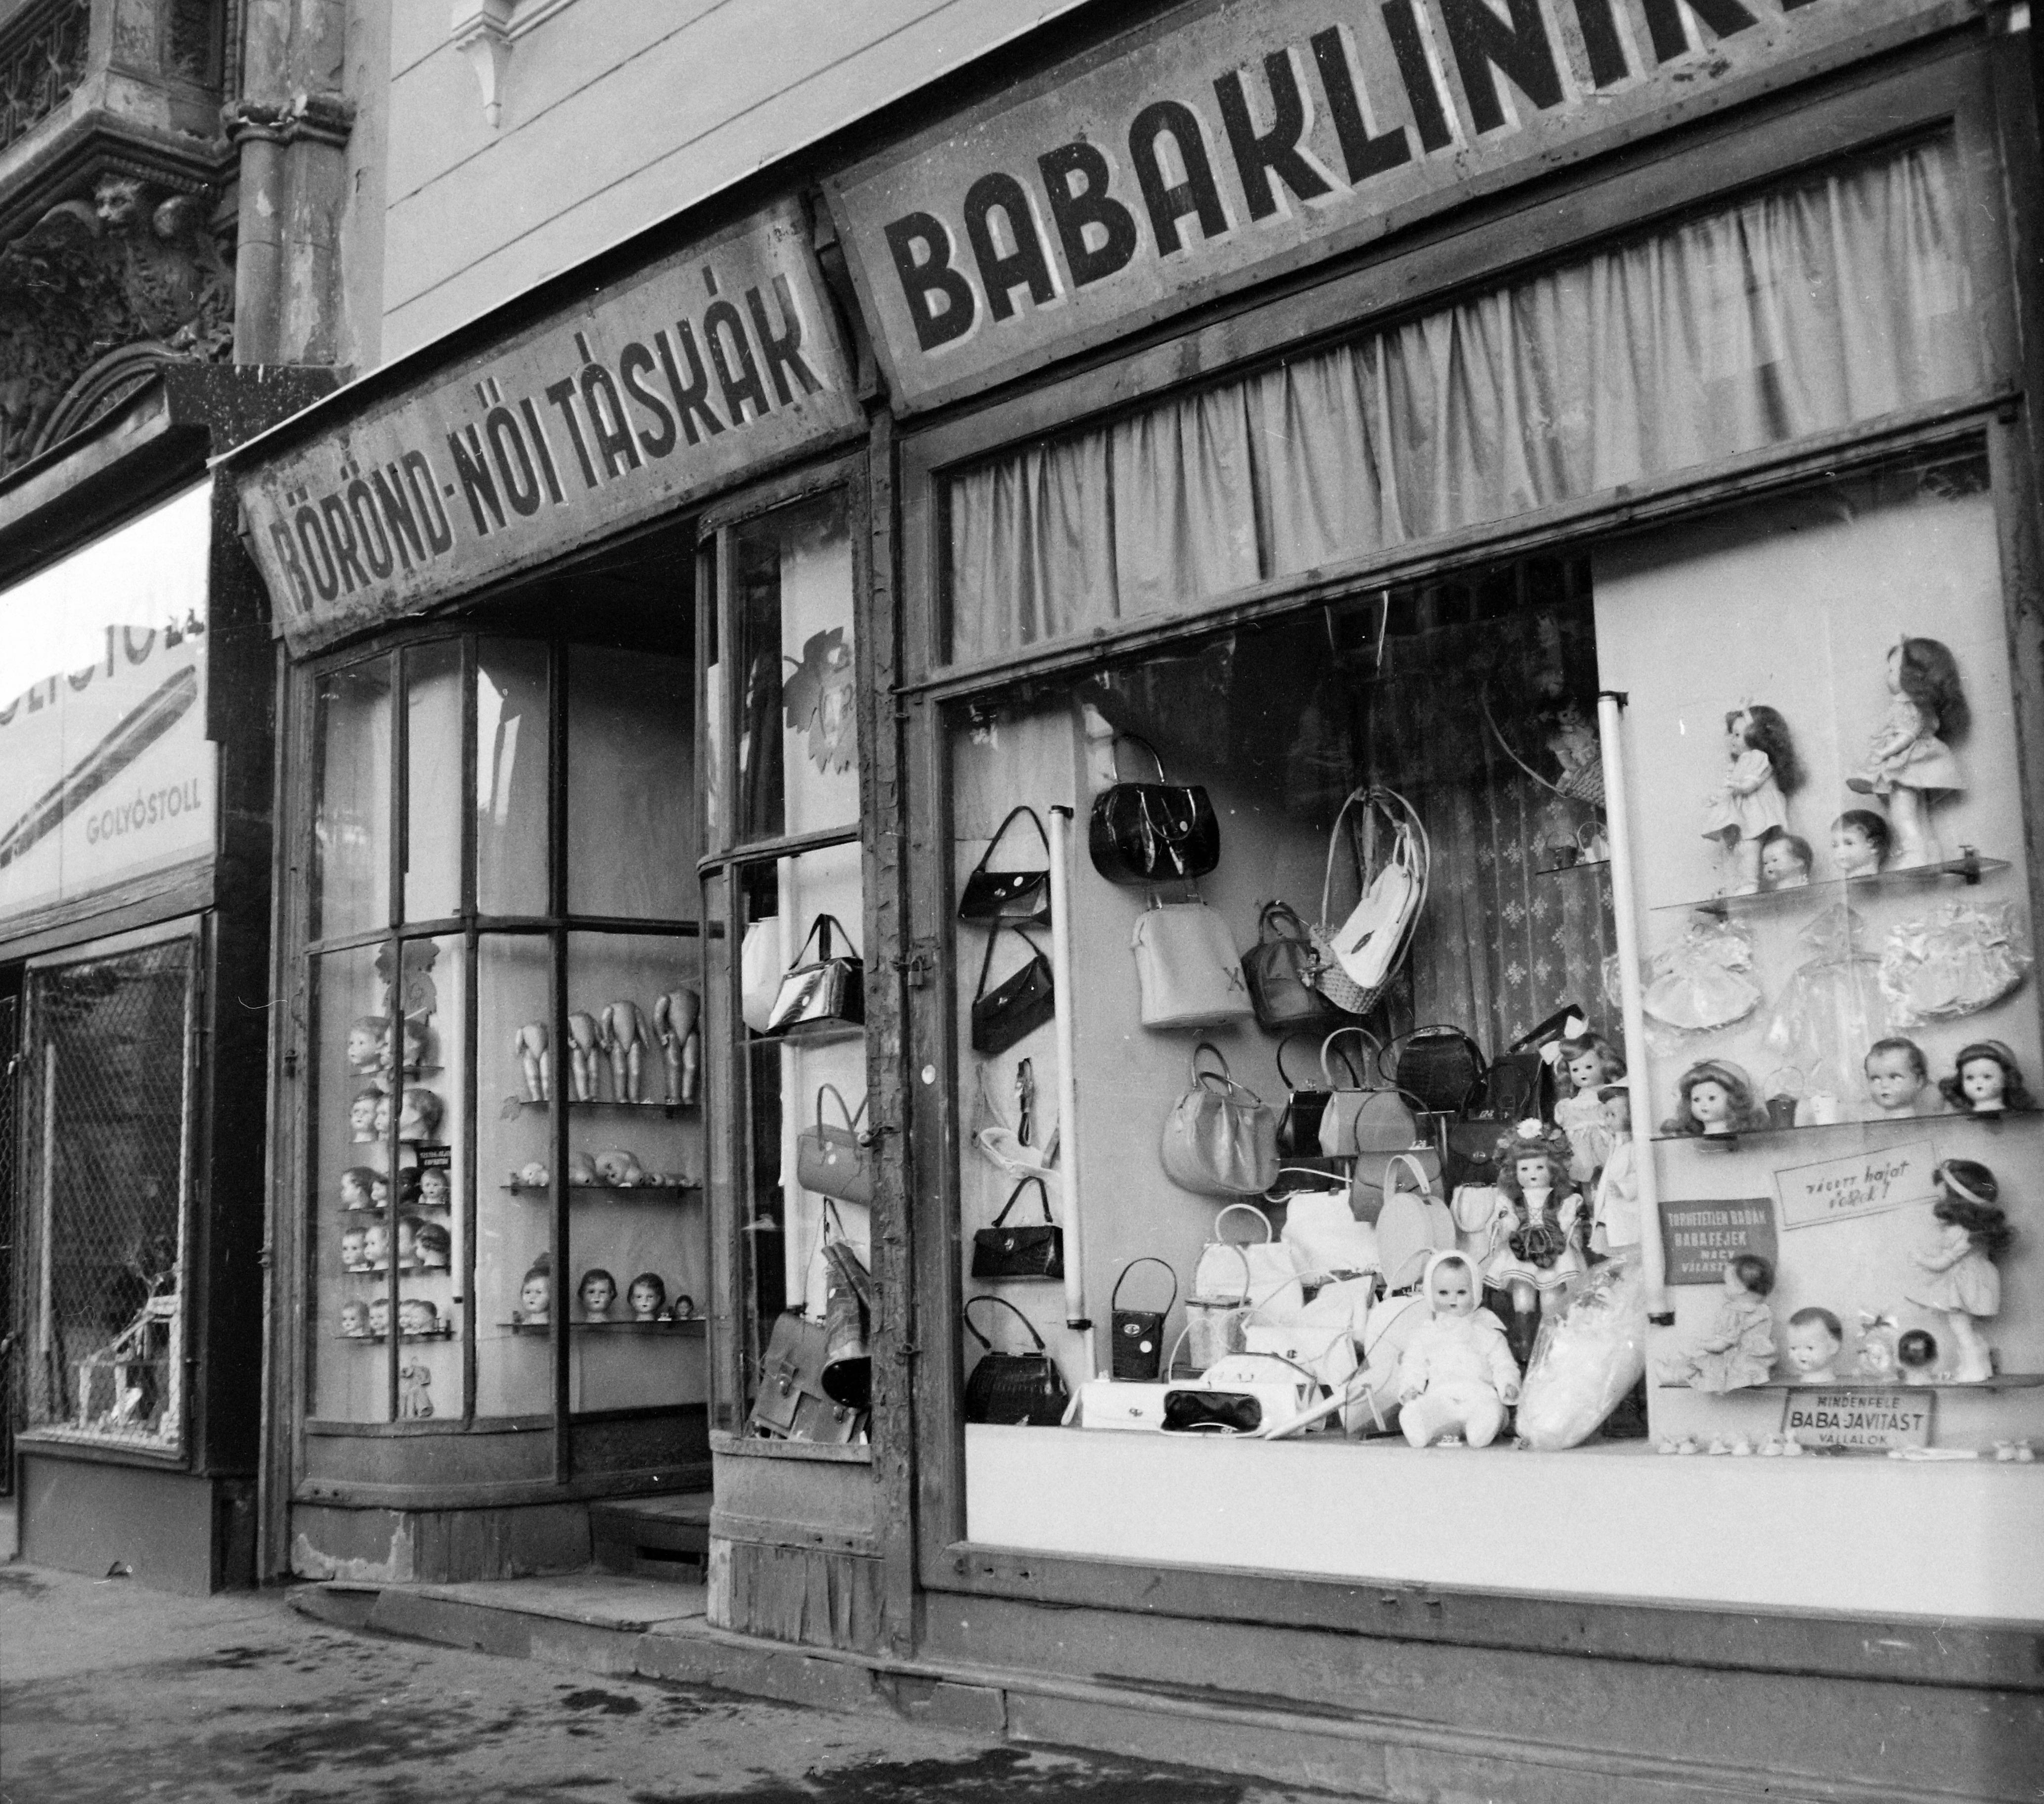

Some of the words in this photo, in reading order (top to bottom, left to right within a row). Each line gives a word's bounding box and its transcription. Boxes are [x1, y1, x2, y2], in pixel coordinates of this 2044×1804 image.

[883, 0, 1819, 354] BABAKLINI
[545, 265, 824, 490] TÁSKÁK
[86, 778, 201, 845] GOLYÓSTOLL
[1864, 1161, 1910, 1185] hajat
[1674, 1231, 1746, 1246] BABAFEJEK
